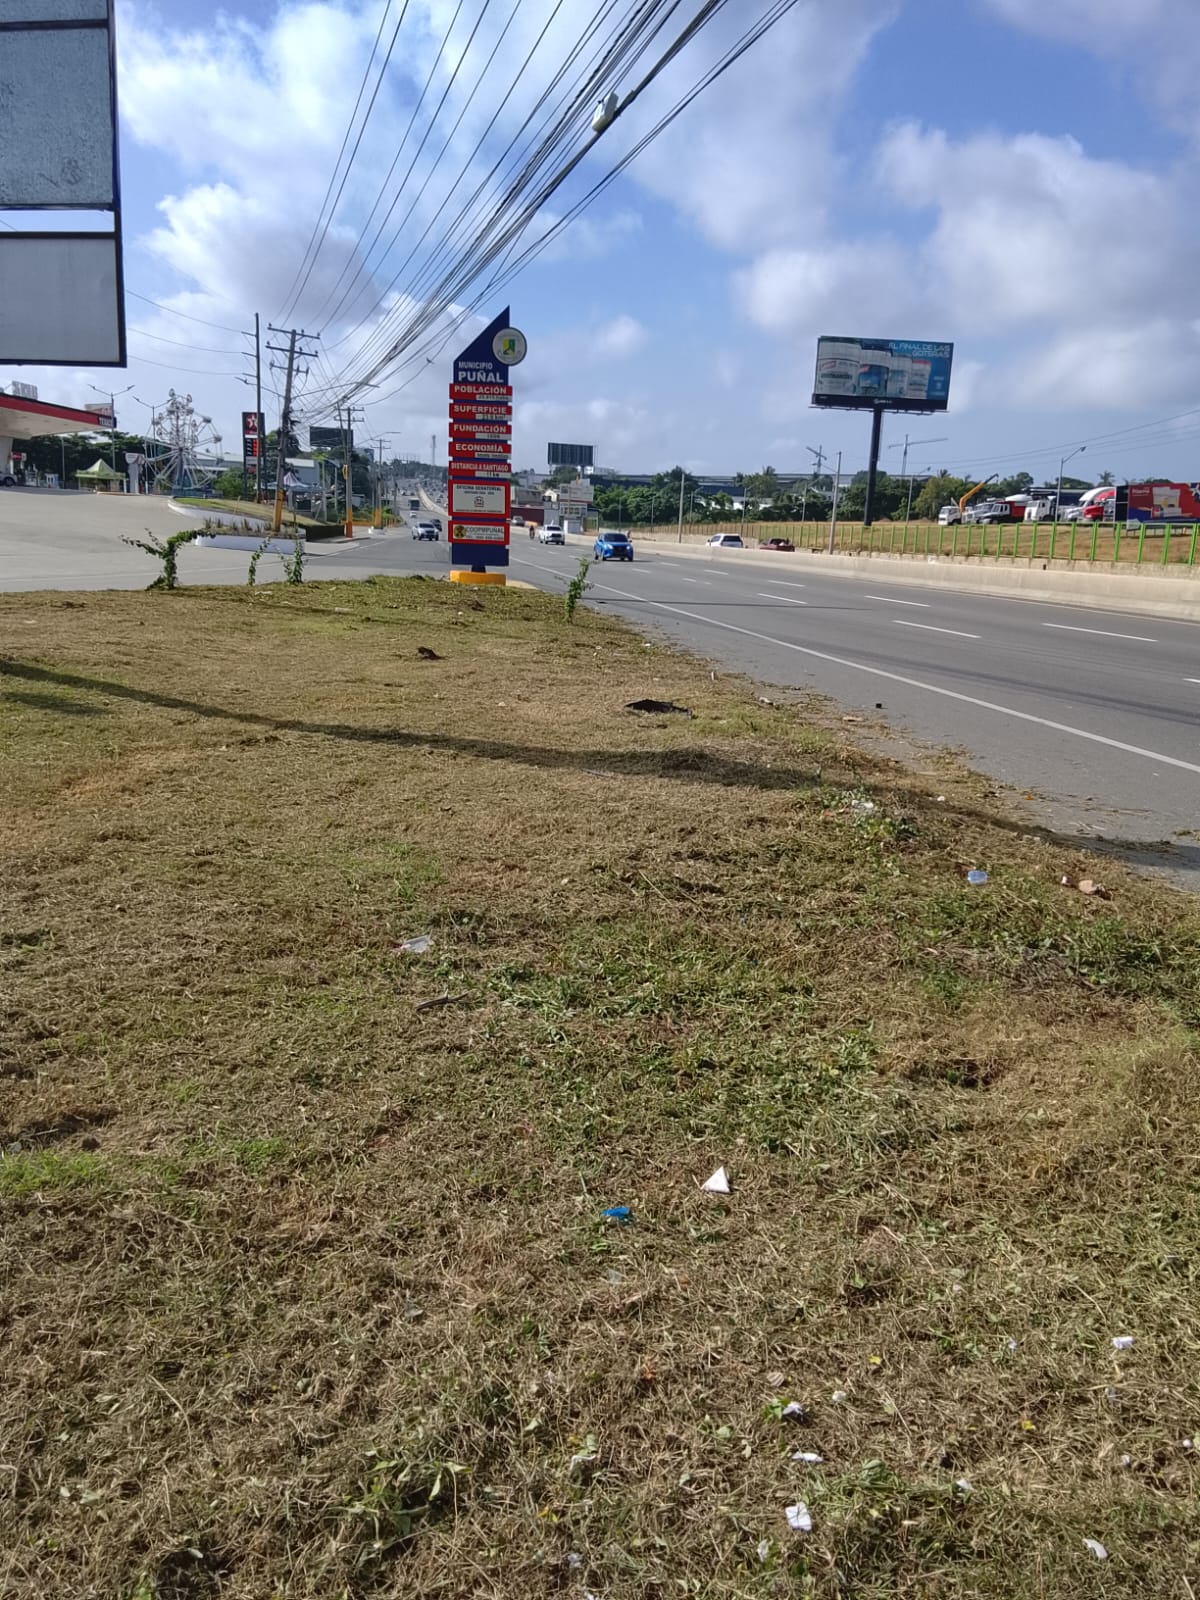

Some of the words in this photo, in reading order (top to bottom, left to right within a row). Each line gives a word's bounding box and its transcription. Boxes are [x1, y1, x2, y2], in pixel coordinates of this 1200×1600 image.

[458, 361, 493, 370] MUNICIPIO
[458, 370, 504, 383] PUÑAL
[454, 385, 507, 394] POBLACIÓN
[453, 405, 507, 414] SUPERFICIE
[453, 424, 506, 433] FUNDACIÓN
[455, 443, 503, 452] ECONOMÍA
[483, 463, 509, 472] SANTIAGO
